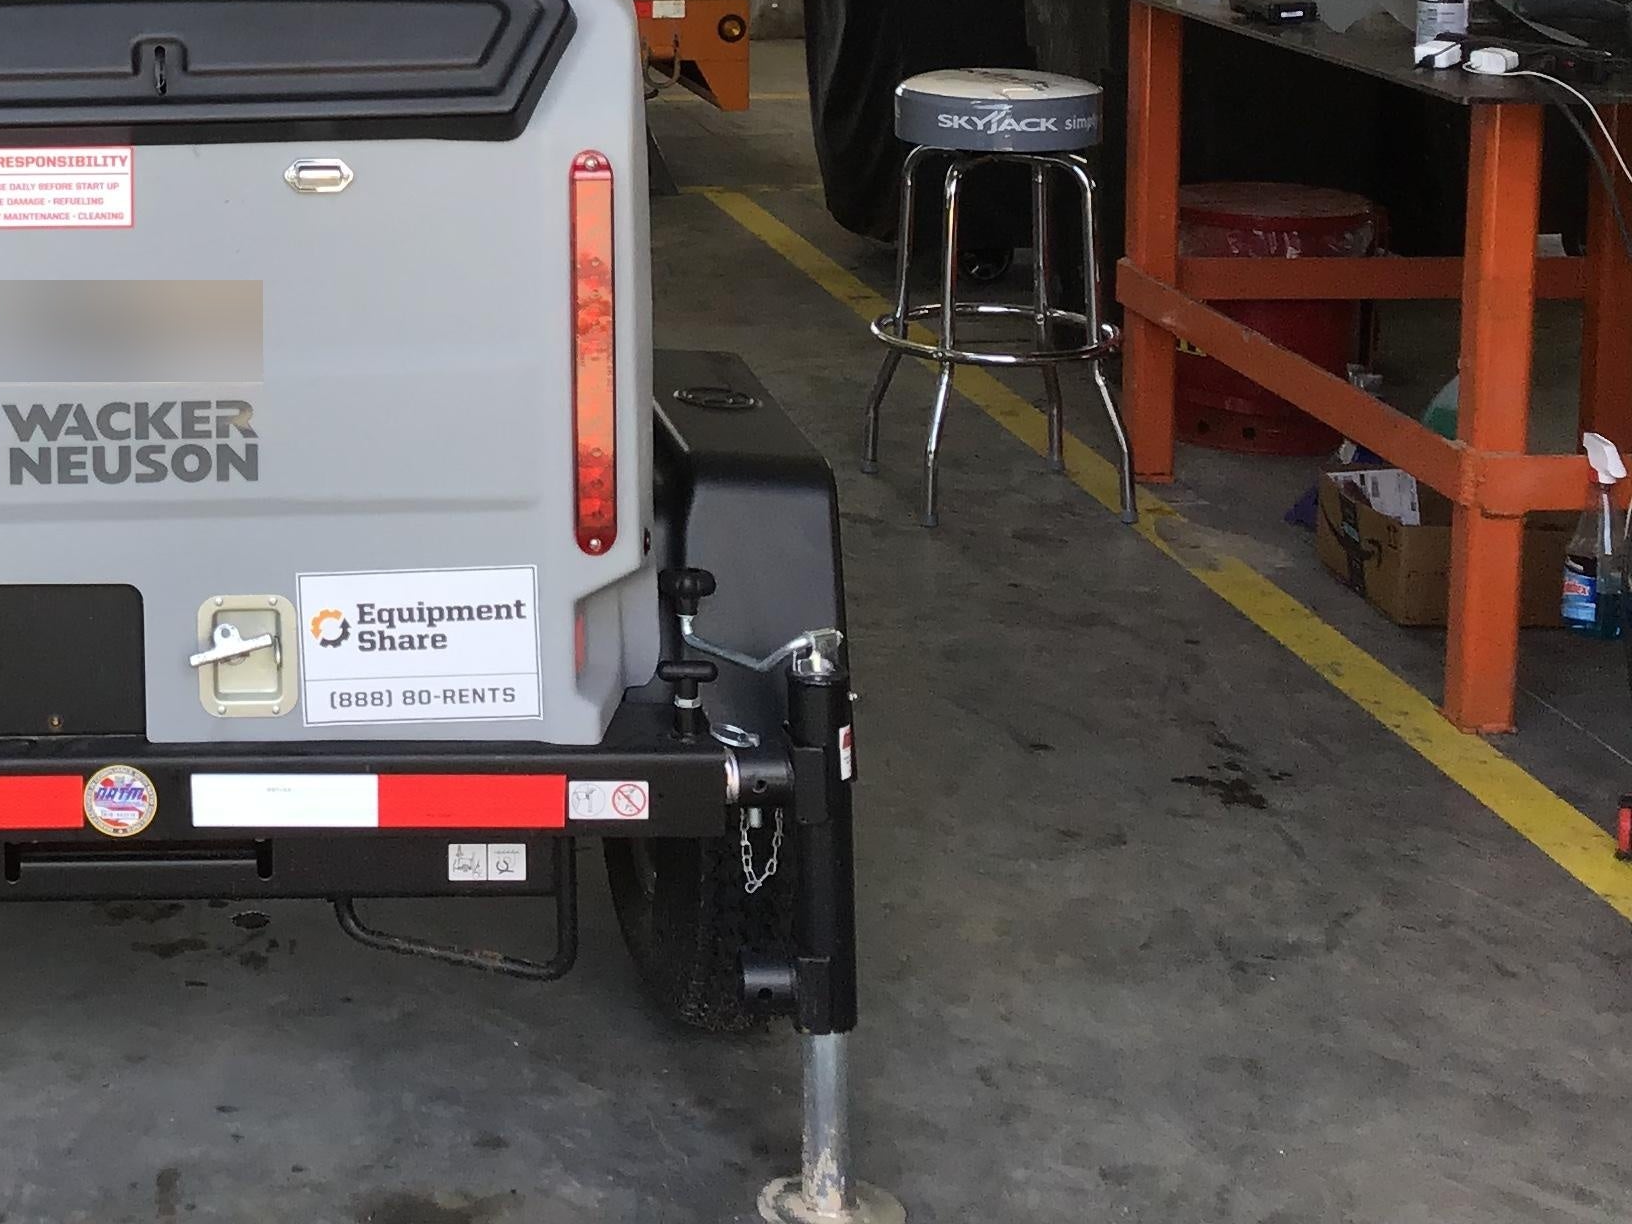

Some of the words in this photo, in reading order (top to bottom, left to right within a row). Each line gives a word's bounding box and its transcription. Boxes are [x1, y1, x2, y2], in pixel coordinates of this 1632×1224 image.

[937, 110, 1058, 135] SKYJACK
[9, 183, 36, 191] DAILY
[38, 182, 73, 191] BEFORE
[76, 182, 104, 190] START
[107, 182, 120, 190] UP
[7, 197, 45, 206] DAMAGE
[53, 197, 104, 205] REFUELING
[3, 212, 71, 221] MAINTENANCE
[77, 211, 125, 220] CLEANING
[1, 399, 259, 442] WACKER
[9, 443, 259, 485] NEUSON
[356, 599, 527, 629] Equipment
[357, 630, 448, 652] Share
[330, 689, 393, 710] (888)
[402, 686, 516, 706] 80-RENTS
